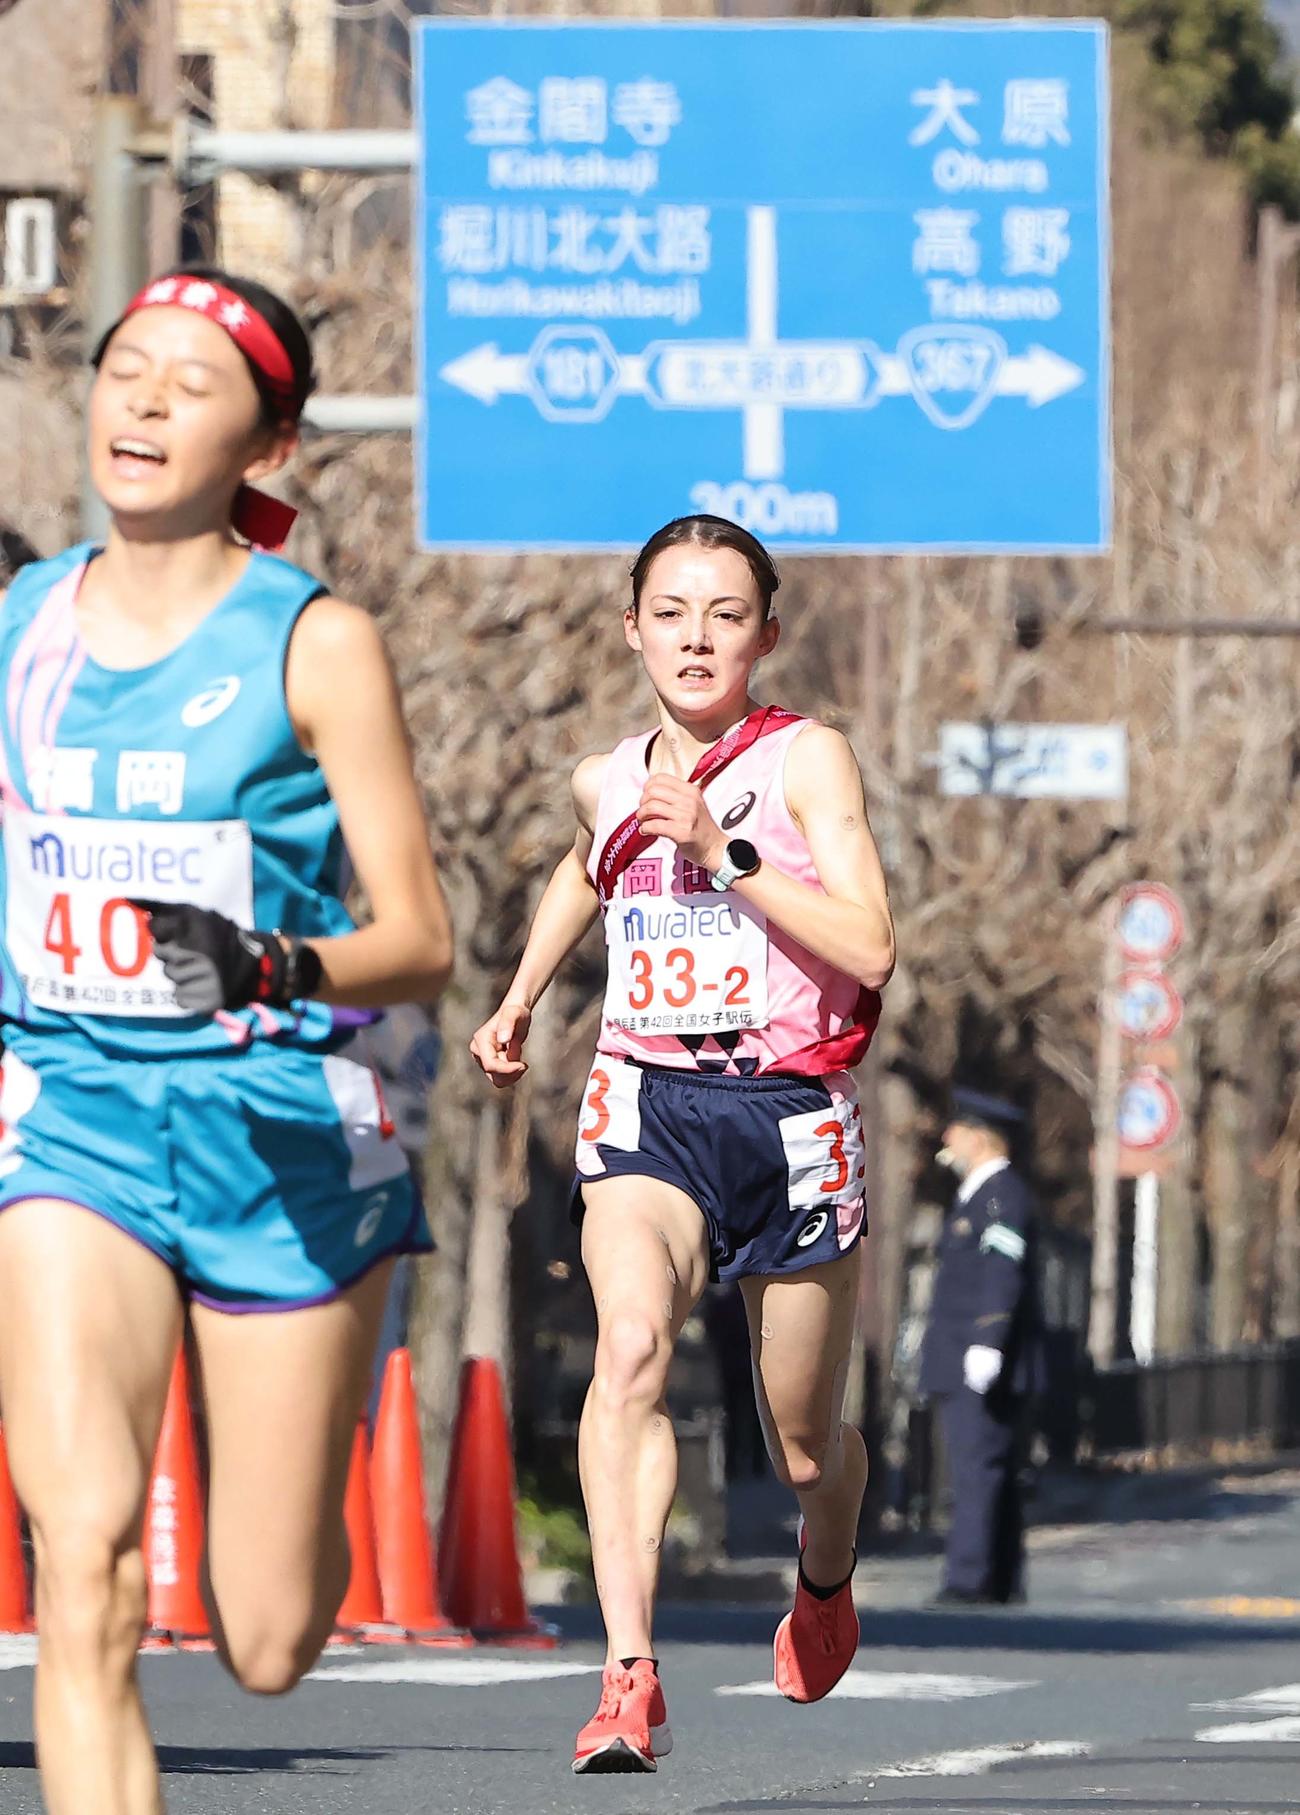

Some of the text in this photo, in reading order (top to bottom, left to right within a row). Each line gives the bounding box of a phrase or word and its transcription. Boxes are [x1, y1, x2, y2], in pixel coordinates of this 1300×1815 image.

[465, 76, 682, 146] 金閣寺
[908, 77, 1071, 146] 大原
[912, 206, 1072, 277] 高野
[913, 341, 992, 393] 367
[628, 947, 750, 1010] 33-2
